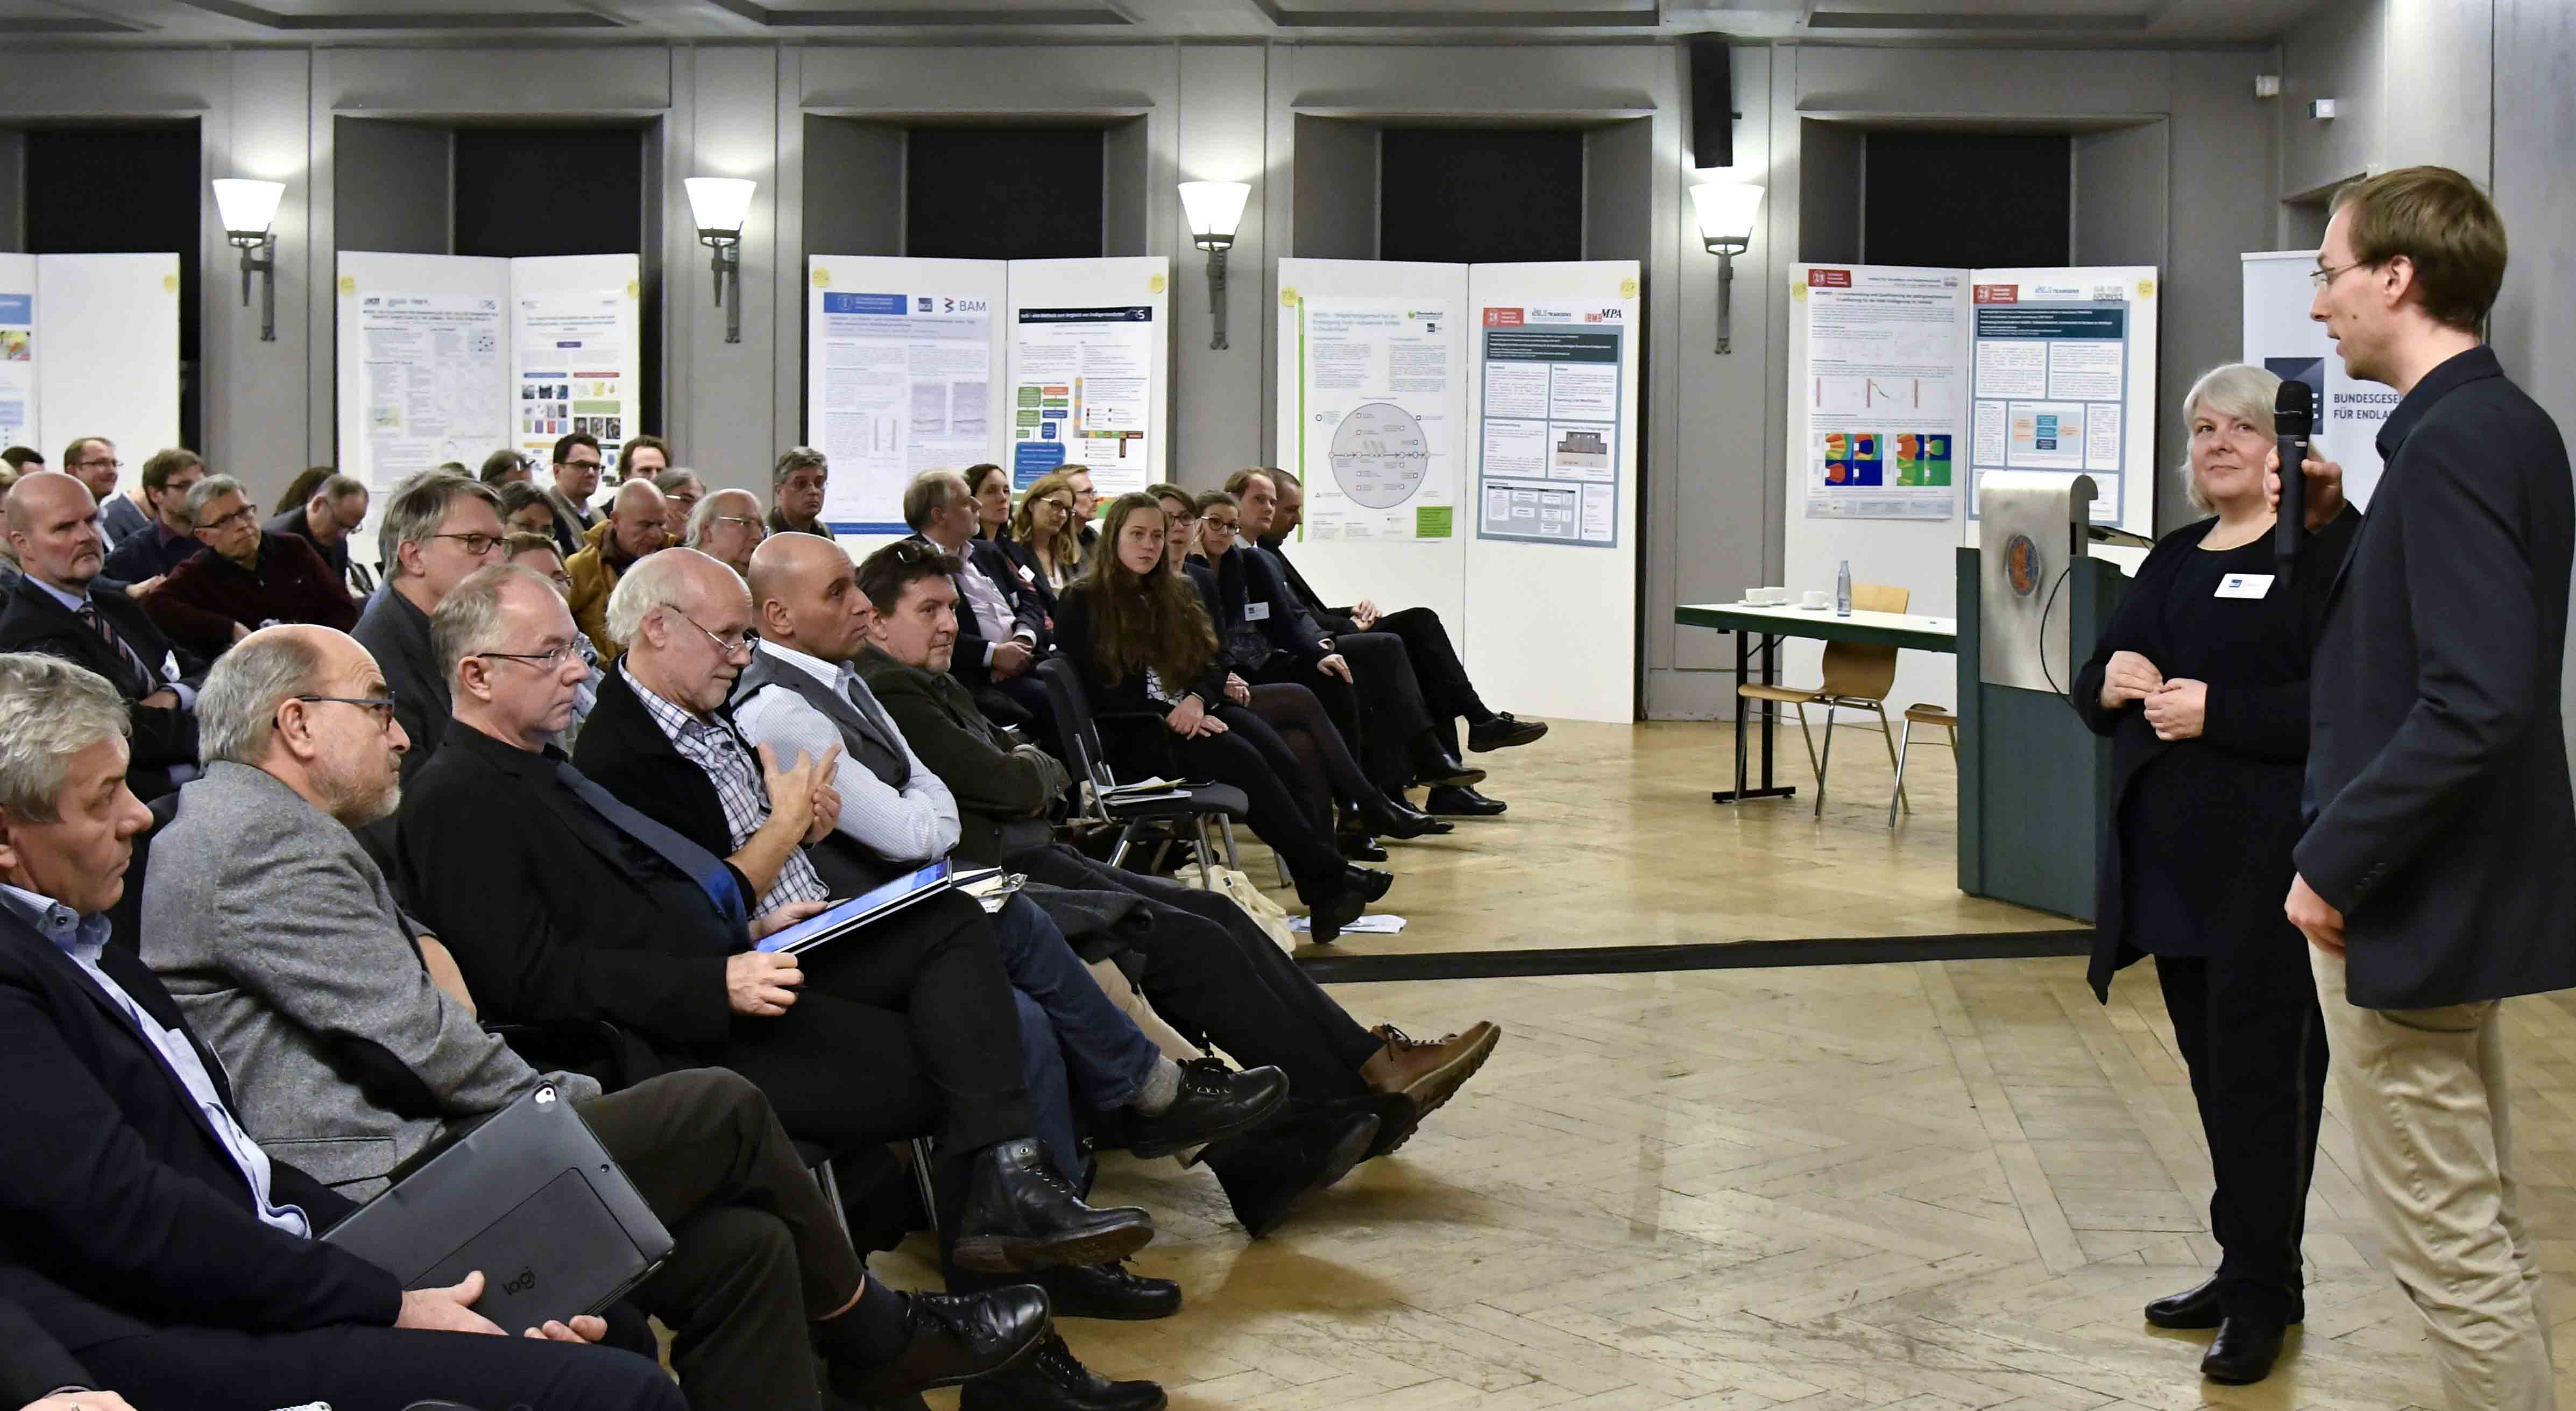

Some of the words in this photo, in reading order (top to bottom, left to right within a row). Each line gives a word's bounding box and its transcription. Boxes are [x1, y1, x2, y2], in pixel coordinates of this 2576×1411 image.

[959, 300, 986, 312] BAM
[1602, 309, 1622, 319] MPA
[2334, 406, 2353, 419] FÜR
[2356, 410, 2390, 420] ENDLA
[500, 1265, 535, 1296] logi
